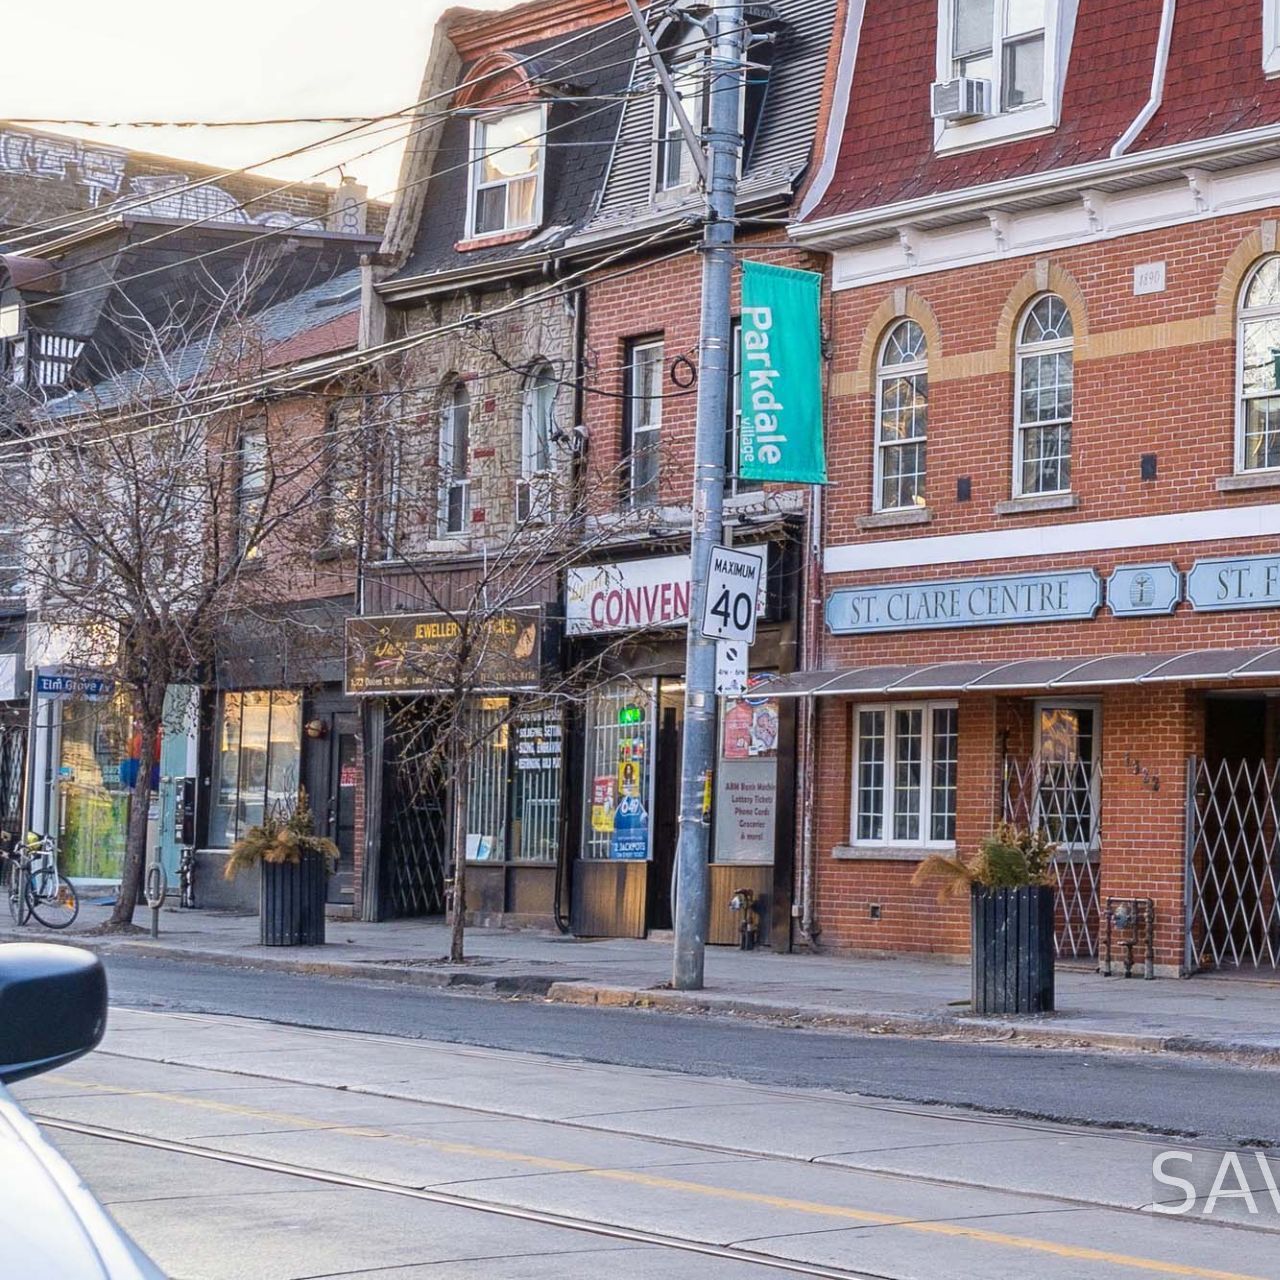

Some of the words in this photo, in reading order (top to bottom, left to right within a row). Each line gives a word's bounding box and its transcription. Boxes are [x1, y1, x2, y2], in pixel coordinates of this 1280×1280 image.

[742, 306, 788, 465] Parkdale
[741, 416, 756, 463] village
[714, 558, 756, 580] MAXIMUM
[1216, 567, 1254, 601] ST.
[590, 580, 691, 629] CONVEN
[710, 588, 752, 631] 40
[850, 595, 880, 625] ST.
[887, 589, 961, 622] CLARE
[968, 579, 1069, 617] CENTRE
[414, 622, 462, 639] JEWELLER
[41, 678, 62, 690] Elm
